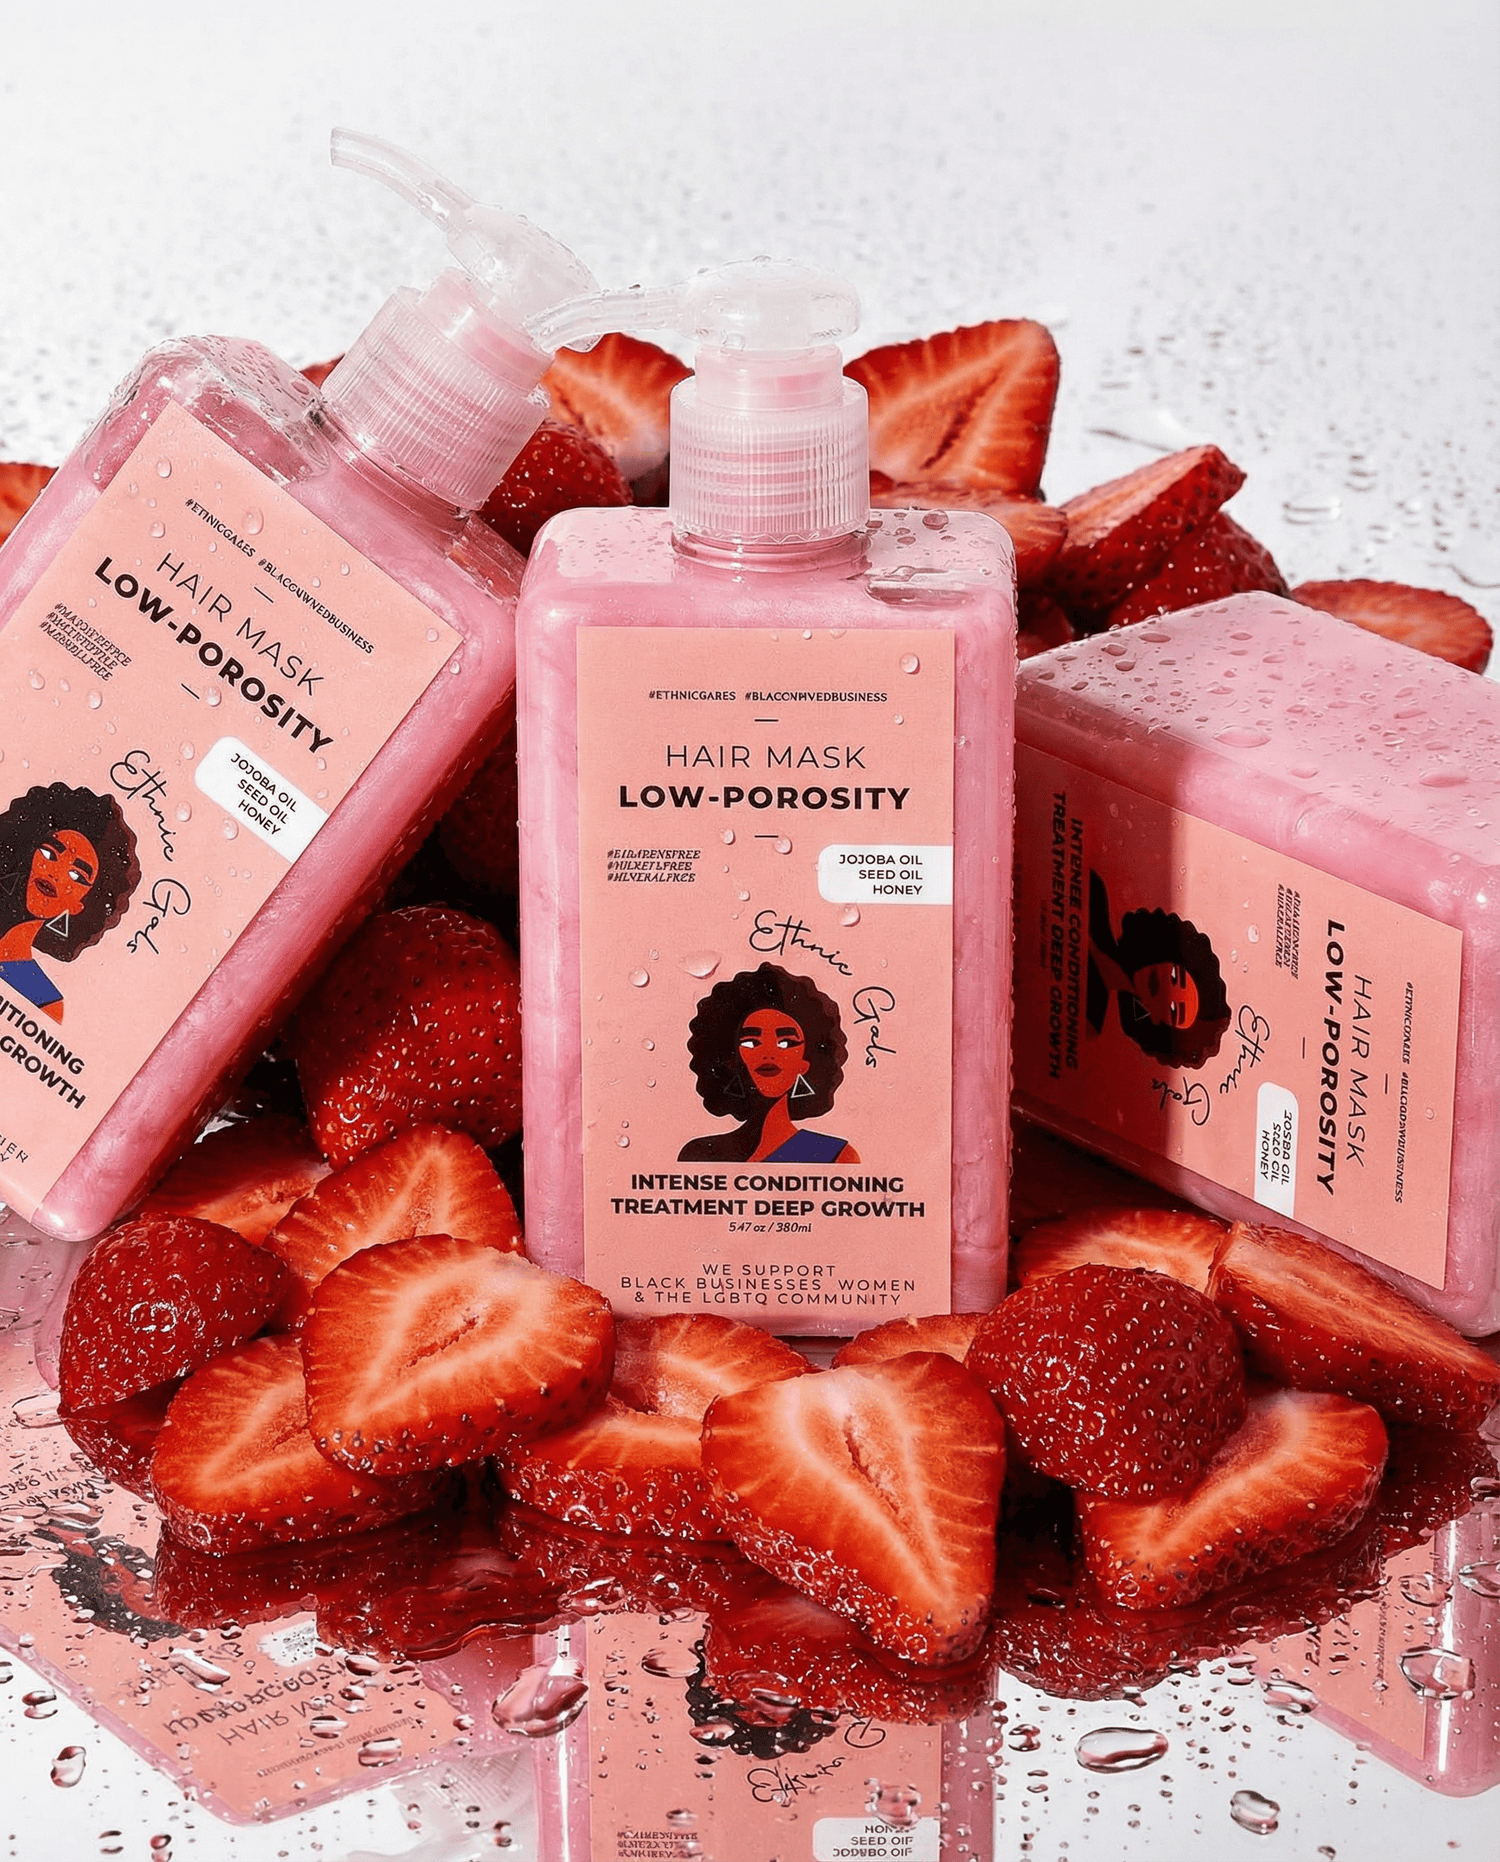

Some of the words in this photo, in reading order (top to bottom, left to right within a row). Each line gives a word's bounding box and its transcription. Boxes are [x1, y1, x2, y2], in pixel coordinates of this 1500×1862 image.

[156, 552, 233, 622] HAIR
[236, 617, 324, 696] MASK
[94, 556, 334, 754] LOW-POROSITY
[666, 745, 751, 768] HAIR
[767, 746, 867, 769] MASK
[230, 752, 277, 797] JOJOBA
[278, 790, 296, 813] OIL
[237, 778, 269, 808] SEED
[269, 802, 288, 824] OIL
[619, 785, 910, 810] LOW-POROSITY
[110, 750, 176, 862] Ethnic
[237, 799, 281, 836] HONEY
[839, 854, 896, 865] JOJOBA
[899, 855, 923, 866] OIL
[858, 869, 896, 880] SEED
[899, 870, 923, 881] OIL
[873, 884, 923, 896] HONEY
[127, 877, 192, 955] Gals
[748, 909, 853, 976] Ethnic
[852, 986, 897, 1068] Gals
[1350, 974, 1372, 1059] HAIR
[0, 1035, 86, 1110] GROWTH
[1316, 918, 1345, 1196] LOW-POROSITY
[1345, 1068, 1369, 1168] MASK
[1260, 1130, 1270, 1180] HONEY
[631, 1174, 728, 1191] INTENSE
[733, 1175, 904, 1193] CONDITIONING
[611, 1198, 748, 1216] TREATMENT
[754, 1199, 815, 1216] DEEP
[821, 1200, 925, 1218] GROWTH
[753, 1224, 766, 1232] oz
[621, 1276, 686, 1289] BLACK
[696, 1278, 822, 1290] BUSINESSES
[838, 1279, 915, 1291] WOMEN
[702, 1263, 732, 1276] WE
[742, 1264, 836, 1277] SUPPORT
[634, 1291, 645, 1303] &
[654, 1291, 692, 1303] THE
[702, 1292, 768, 1305] LGBTQ
[777, 1293, 901, 1305] COMMUNITY
